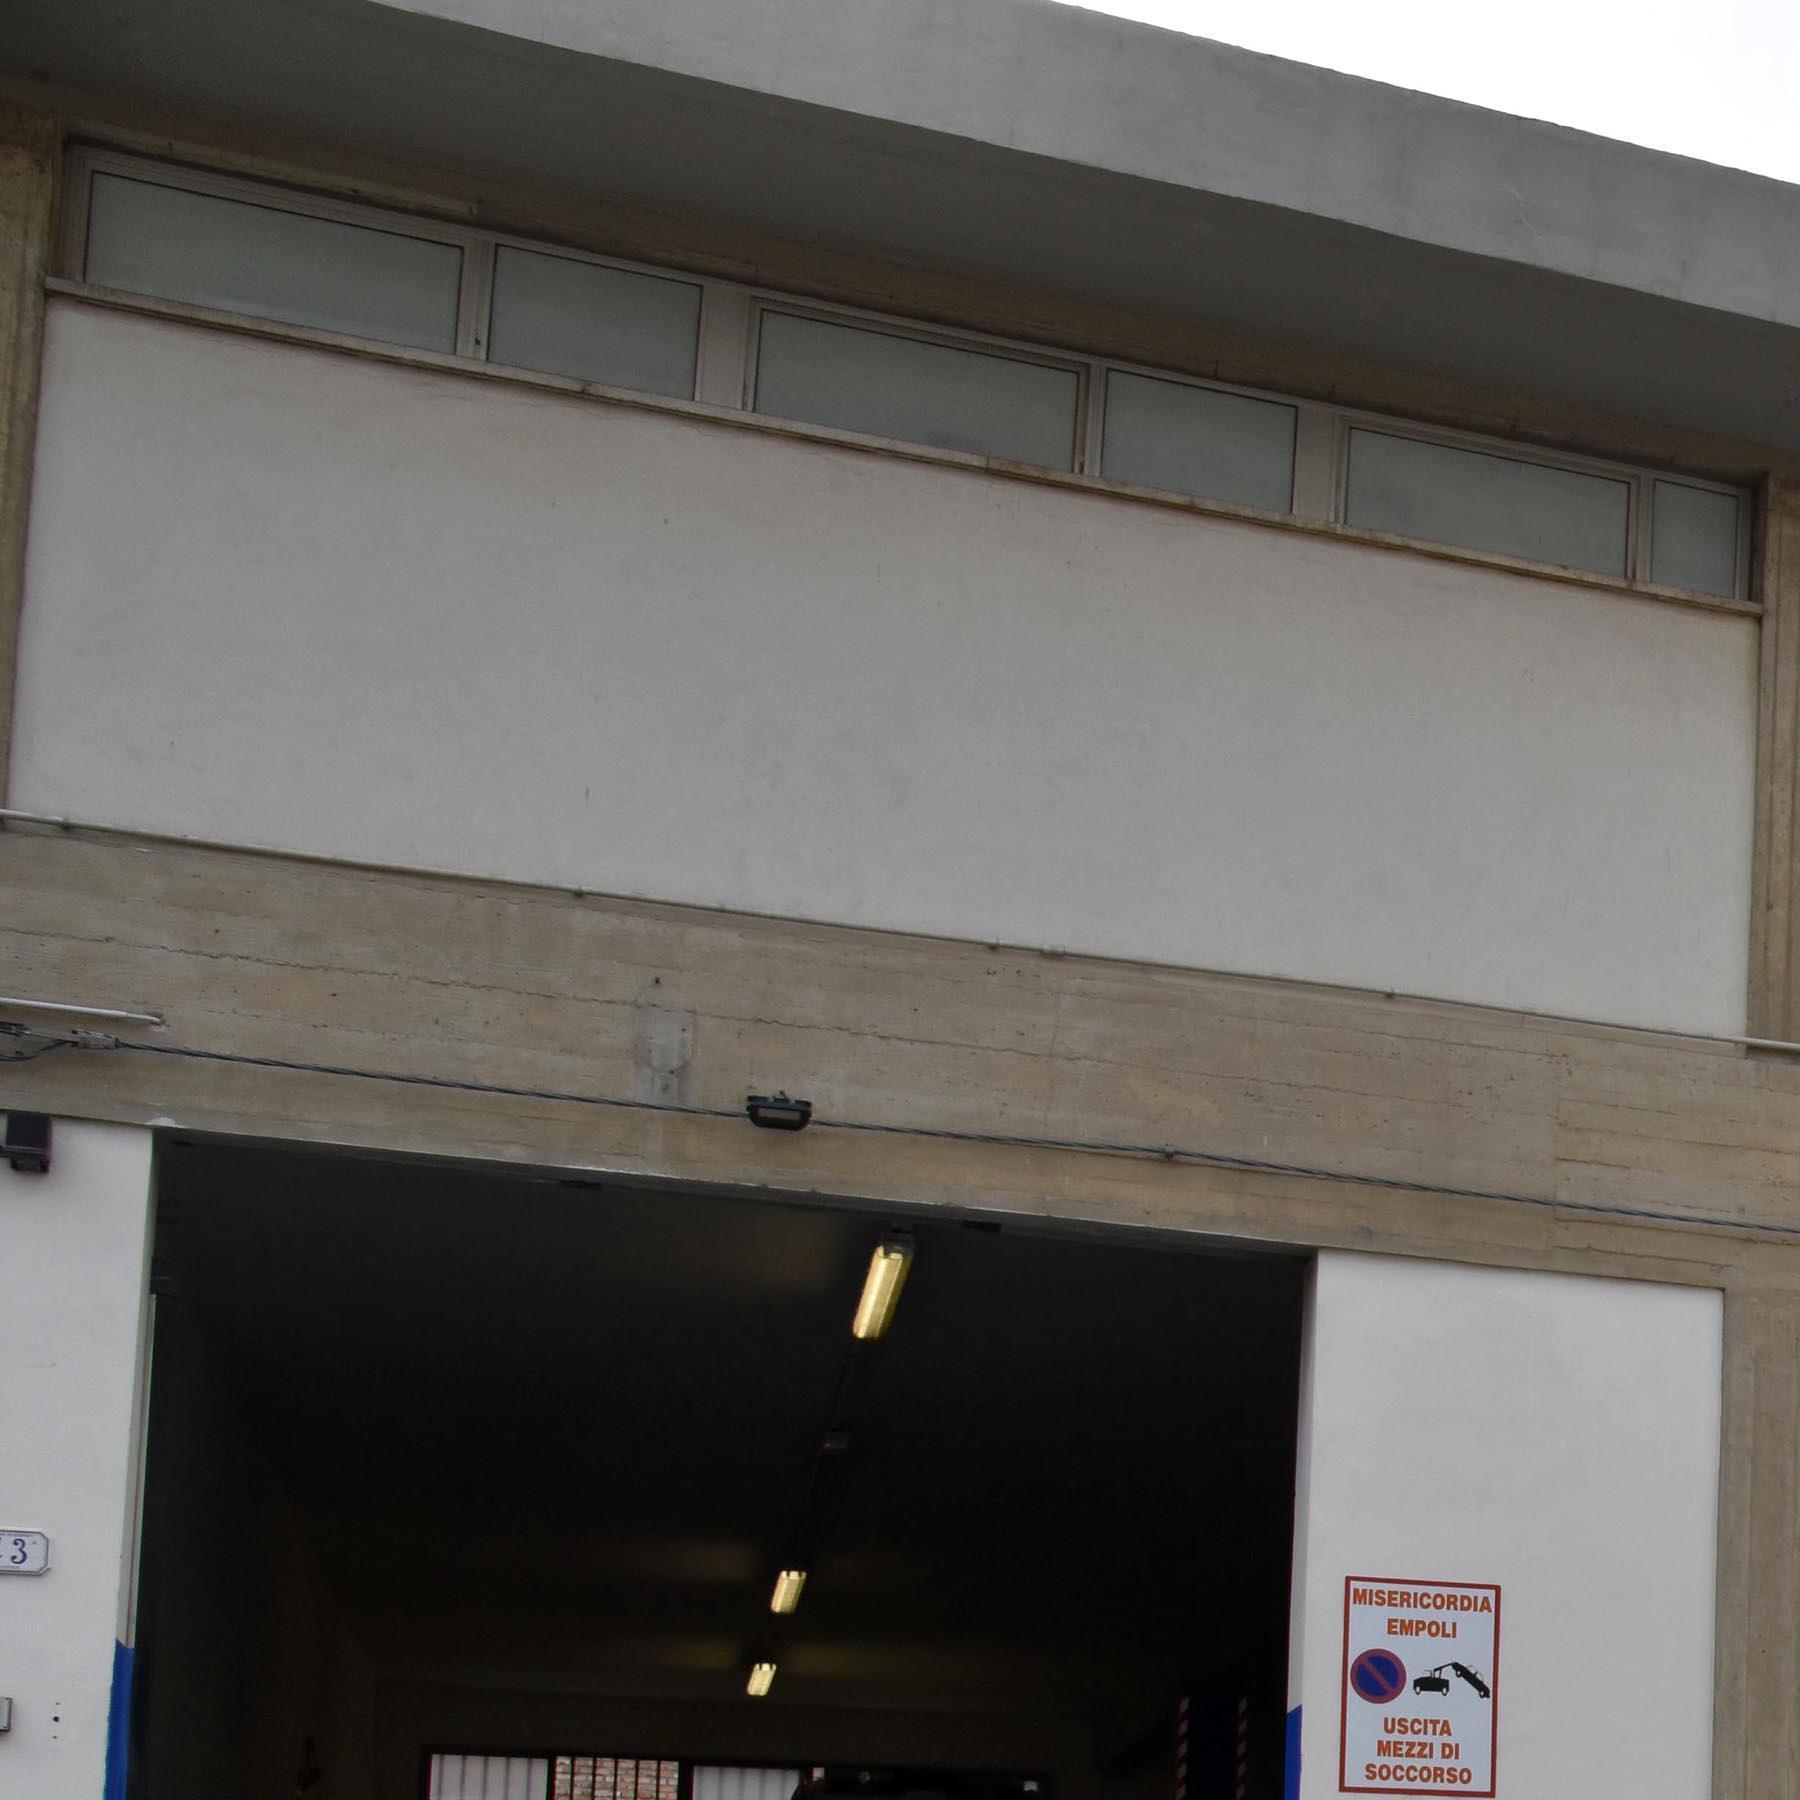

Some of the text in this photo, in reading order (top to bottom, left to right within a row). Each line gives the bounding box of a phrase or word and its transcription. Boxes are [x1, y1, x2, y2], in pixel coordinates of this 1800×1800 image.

[1352, 1587, 1493, 1613] MISERICORDIA
[1386, 1618, 1458, 1639] EMPOLI
[1383, 1716, 1453, 1737] USCITA
[1376, 1739, 1460, 1760] MEZZI DI
[1364, 1763, 1473, 1785] SOCCORSO
